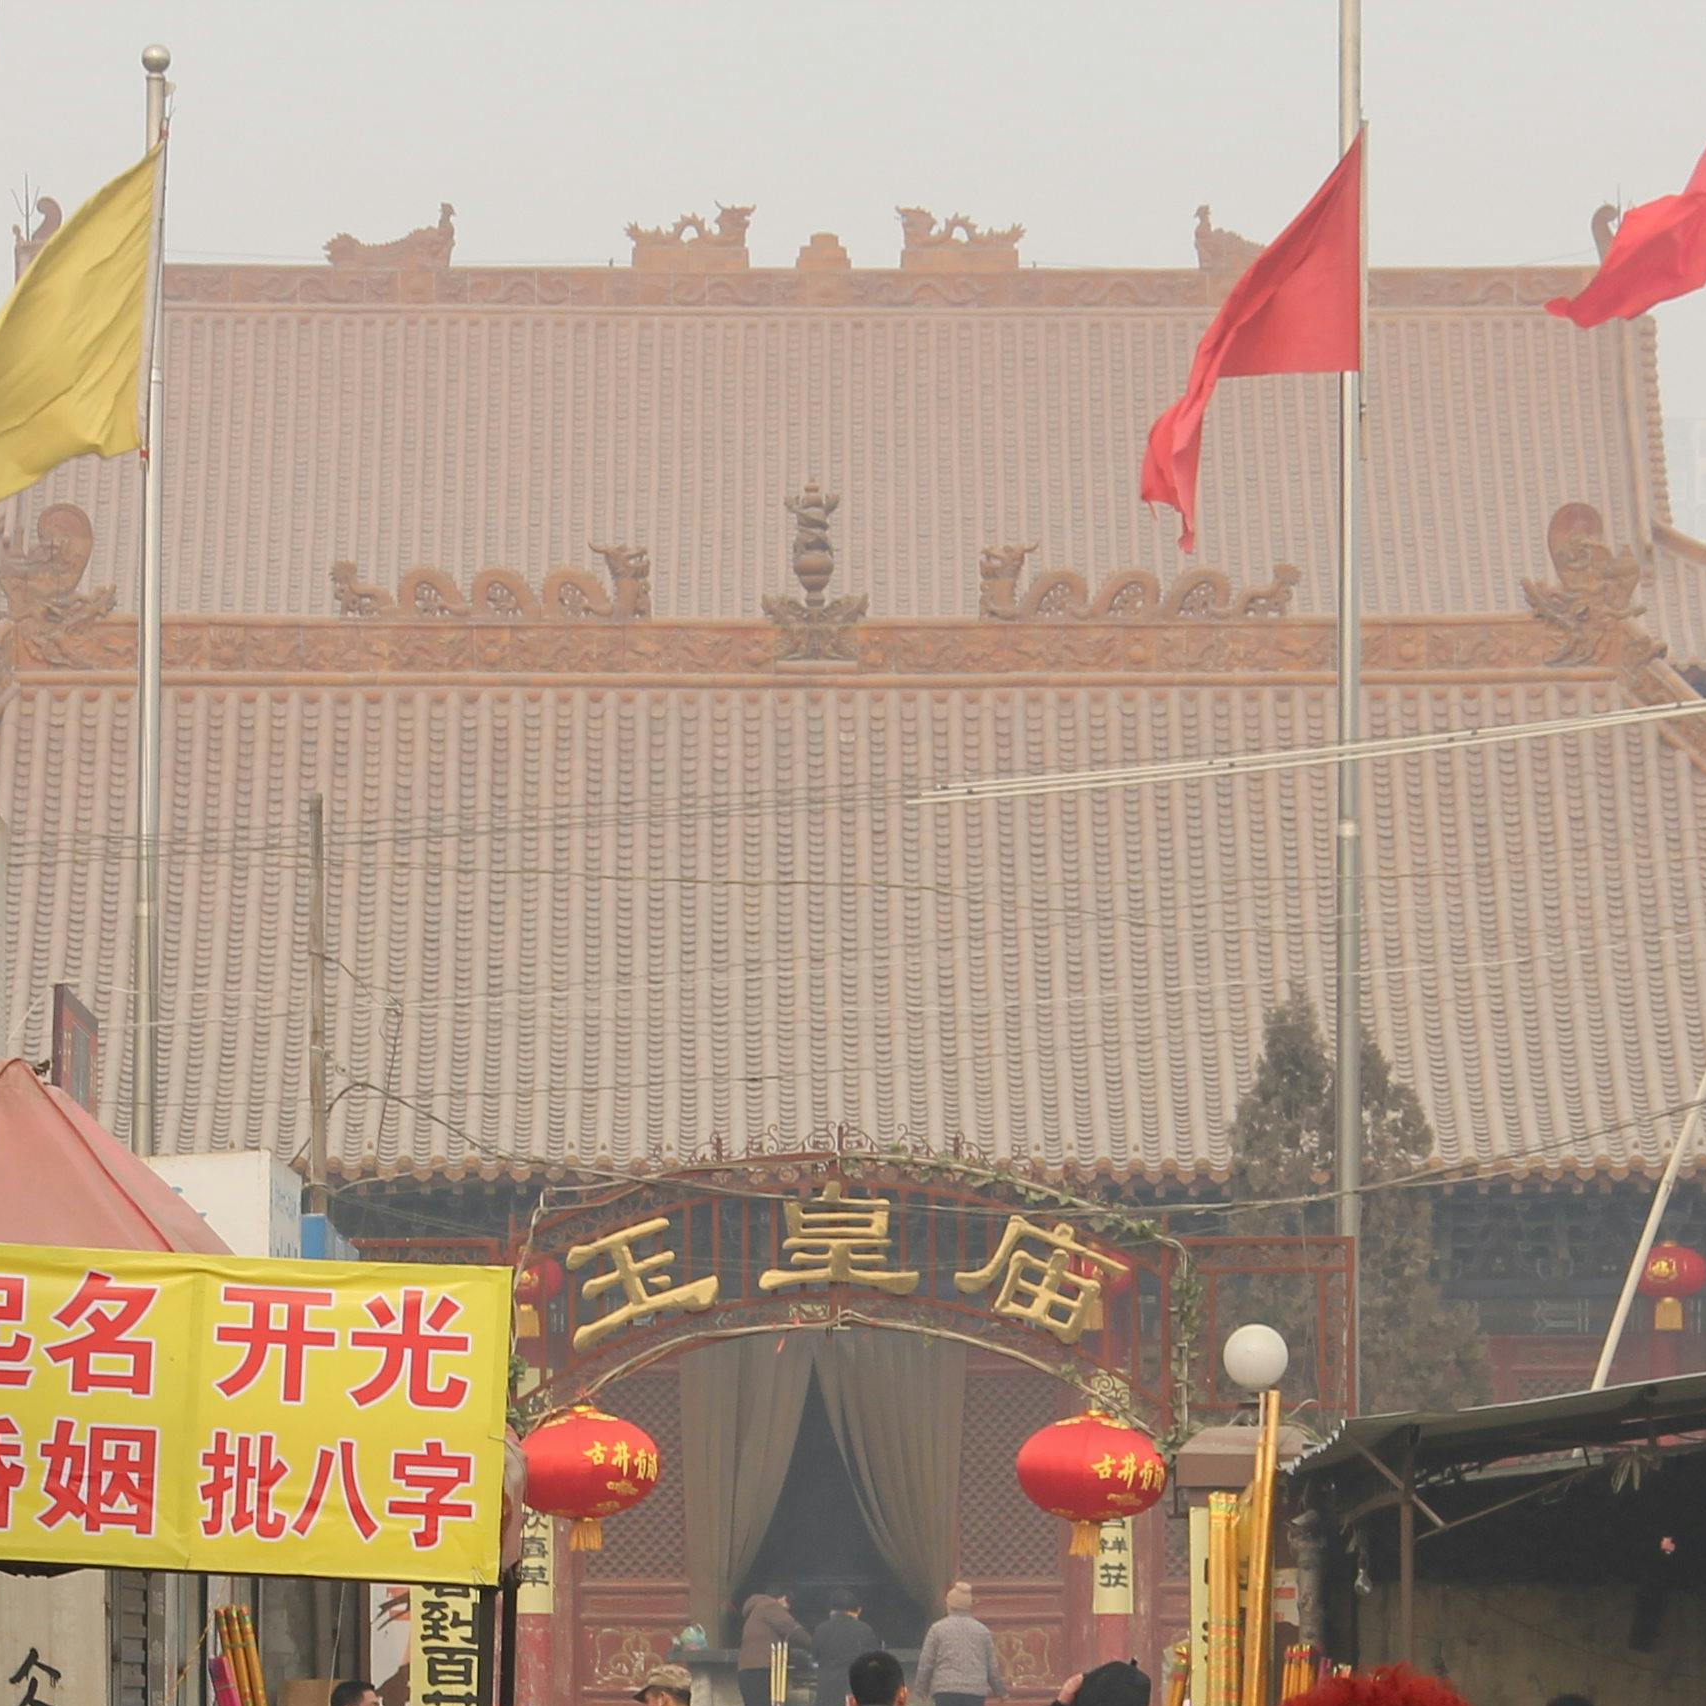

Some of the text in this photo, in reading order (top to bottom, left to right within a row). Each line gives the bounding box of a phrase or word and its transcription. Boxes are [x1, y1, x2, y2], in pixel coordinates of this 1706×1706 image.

[566, 1180, 1131, 1354] 玉皇庙
[213, 1283, 473, 1410] 开光
[198, 1428, 477, 1552] 批八字
